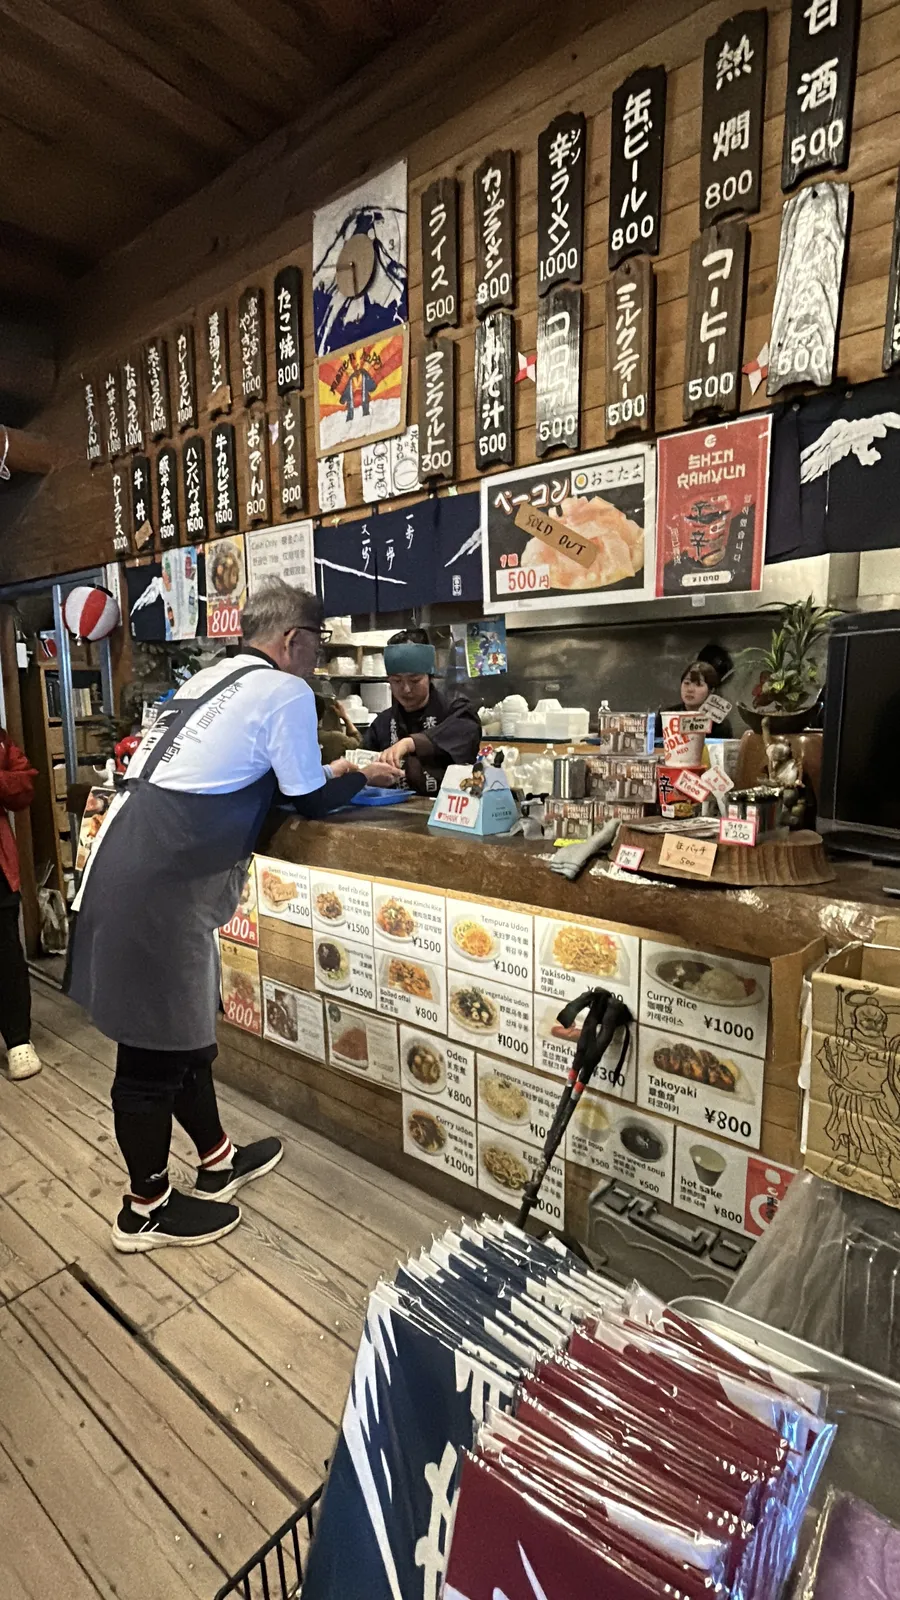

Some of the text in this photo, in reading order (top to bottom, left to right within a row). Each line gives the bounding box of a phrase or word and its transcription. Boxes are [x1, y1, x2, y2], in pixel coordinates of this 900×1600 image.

[711, 34, 754, 162] 熱燗
[623, 88, 653, 219] 缶ビール
[791, 119, 844, 164] 500
[548, 132, 572, 256] 辛ラーメン
[705, 169, 753, 210] 800
[482, 167, 505, 280] カップラーメン
[611, 215, 654, 251] 800
[429, 203, 449, 291] ライス
[477, 273, 509, 304] 800
[426, 295, 454, 322] 500
[701, 248, 733, 365] コーヒー
[278, 287, 296, 360] たこ焼
[240, 313, 254, 380] やきそば
[613, 283, 642, 398] ミルクティー
[177, 334, 190, 409] カレーうどん
[547, 311, 570, 409] ココア
[278, 362, 298, 385] 800
[688, 371, 734, 401] 500
[426, 352, 446, 453] フランクフルト
[608, 394, 645, 426] 500
[539, 414, 576, 441] 500
[283, 409, 298, 479] もつ煮
[479, 433, 507, 456] 500
[247, 423, 263, 496] おでん
[421, 450, 451, 472] 300
[688, 448, 734, 470] SHIN
[186, 447, 200, 517] ハンバーグ丼
[215, 434, 230, 509] 牛カルビ丼
[677, 463, 746, 489] RAMYUN
[112, 474, 124, 535] カレーライス
[134, 468, 146, 521] 牛丼
[282, 485, 301, 503] 800
[494, 479, 570, 515] ベーコン
[215, 508, 232, 523] 1500
[246, 498, 266, 515] 800
[160, 523, 174, 538] 1500
[187, 516, 204, 532] 1500
[527, 514, 586, 556] SOLD OUT
[212, 609, 238, 633] 800
[660, 776, 674, 804] 辛
[447, 795, 469, 814] TIP
[442, 813, 470, 825] THANK YOU
[733, 831, 750, 840] 200
[680, 857, 695, 866] 500
[338, 884, 350, 892] Beef
[288, 902, 310, 917] ¥1500
[346, 921, 370, 936] ¥1500
[482, 915, 529, 934] Tempura Udon
[412, 936, 441, 954] ¥1500
[493, 959, 528, 979] ¥1000
[541, 967, 576, 983] Yakisoba
[355, 986, 373, 999] 1500
[380, 988, 412, 1004] Boiled offal
[485, 988, 529, 1008] vegetable udon
[646, 990, 698, 1011] Curry Rice
[415, 1006, 438, 1022] ¥800
[704, 1015, 754, 1041] ¥1000
[498, 1033, 529, 1055] ¥1000
[446, 1049, 468, 1065] Oden
[493, 1068, 521, 1085] Tempura
[522, 1079, 543, 1093] scraps
[648, 1075, 697, 1099] Takoyaki
[447, 1087, 472, 1108] ¥800
[435, 1115, 474, 1137] Curry udon
[704, 1107, 752, 1138] ¥800
[443, 1154, 474, 1177] ¥1000
[591, 1156, 610, 1170] ¥500
[613, 1151, 625, 1161] Sea
[625, 1156, 646, 1170] weed
[647, 1164, 666, 1179] soup
[639, 1179, 660, 1194] ¥500
[680, 1176, 697, 1190] hot
[699, 1186, 723, 1200] sake
[714, 1205, 742, 1224] ¥800
